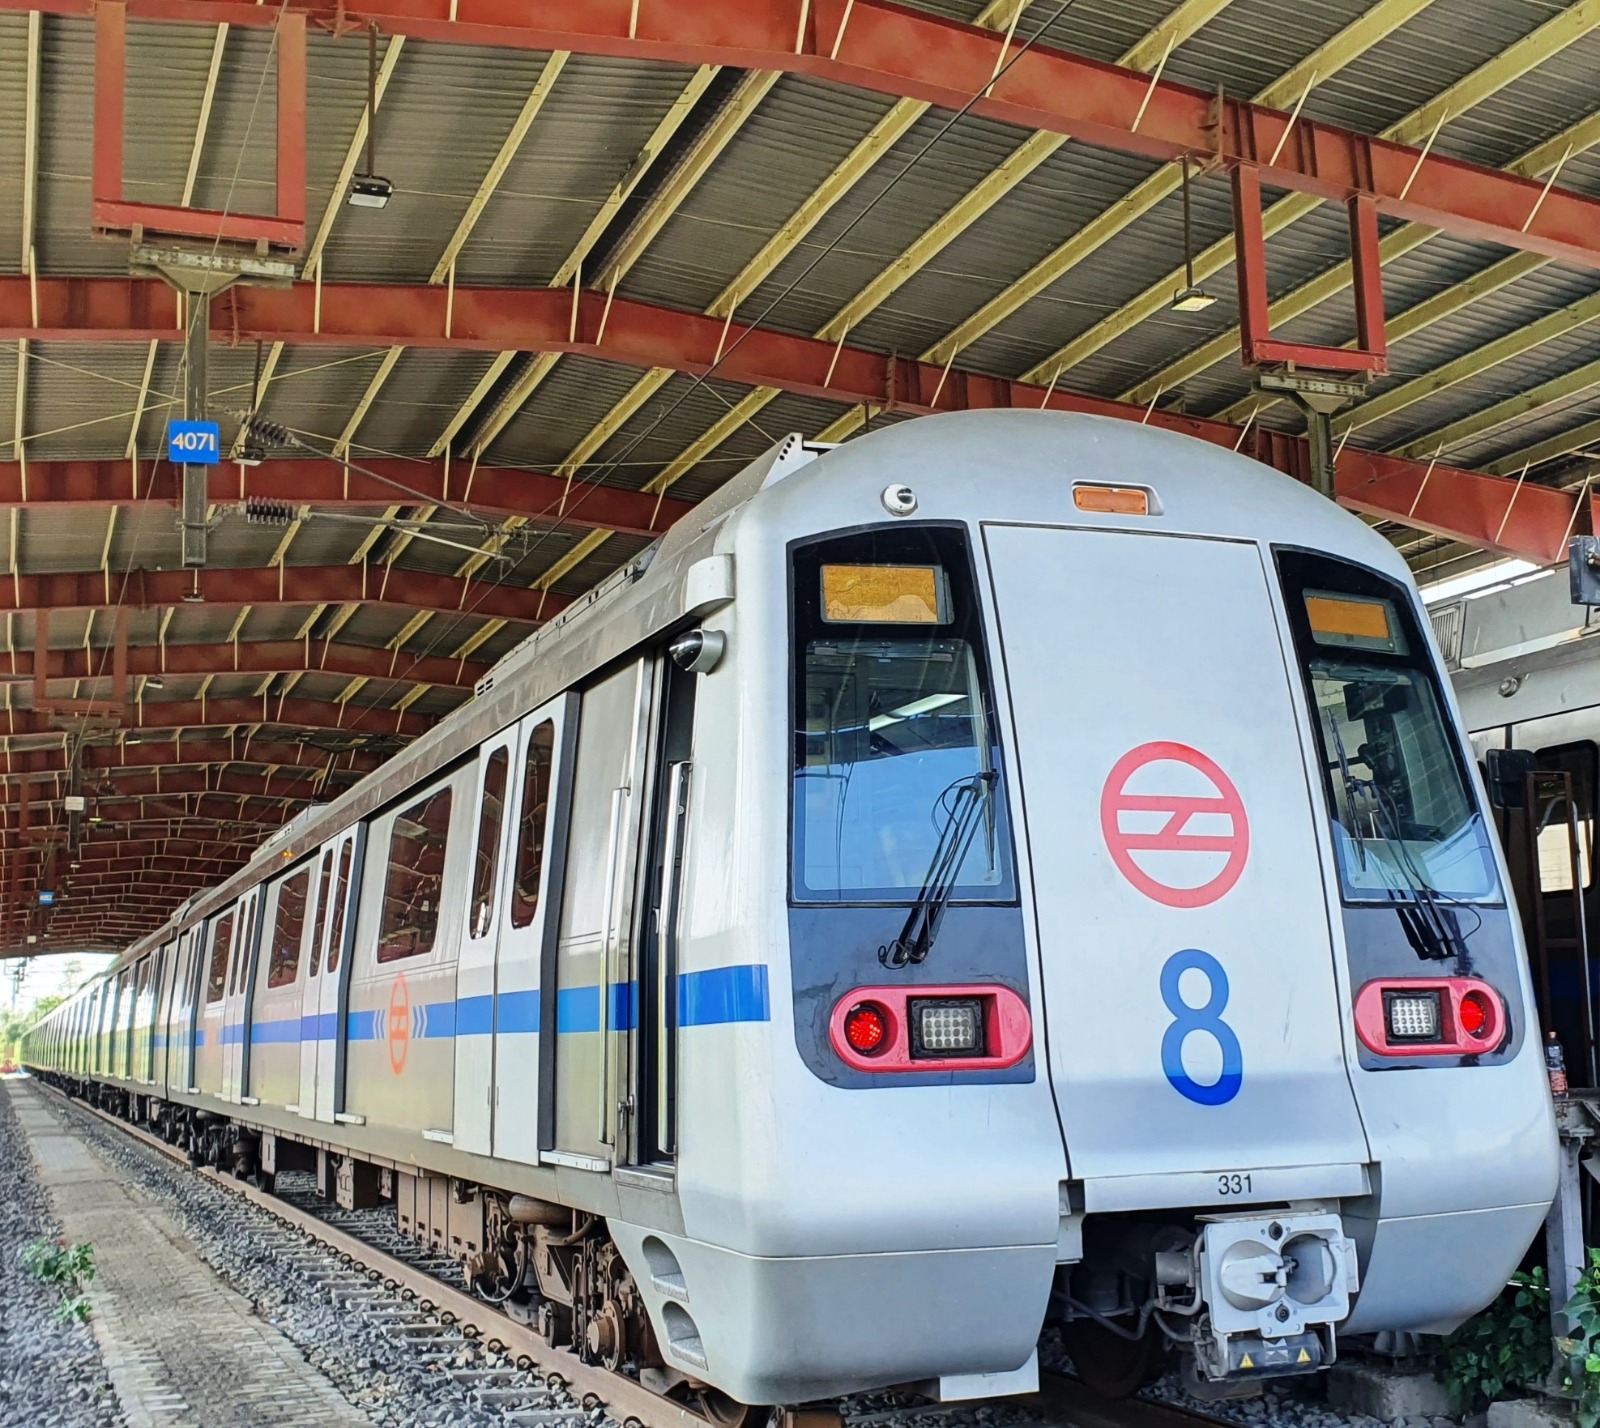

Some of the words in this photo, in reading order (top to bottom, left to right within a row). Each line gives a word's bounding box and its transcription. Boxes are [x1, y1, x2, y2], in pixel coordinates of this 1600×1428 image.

[171, 432, 215, 452] 4071
[1159, 948, 1243, 1106] 8
[1217, 1173, 1253, 1196] 331
